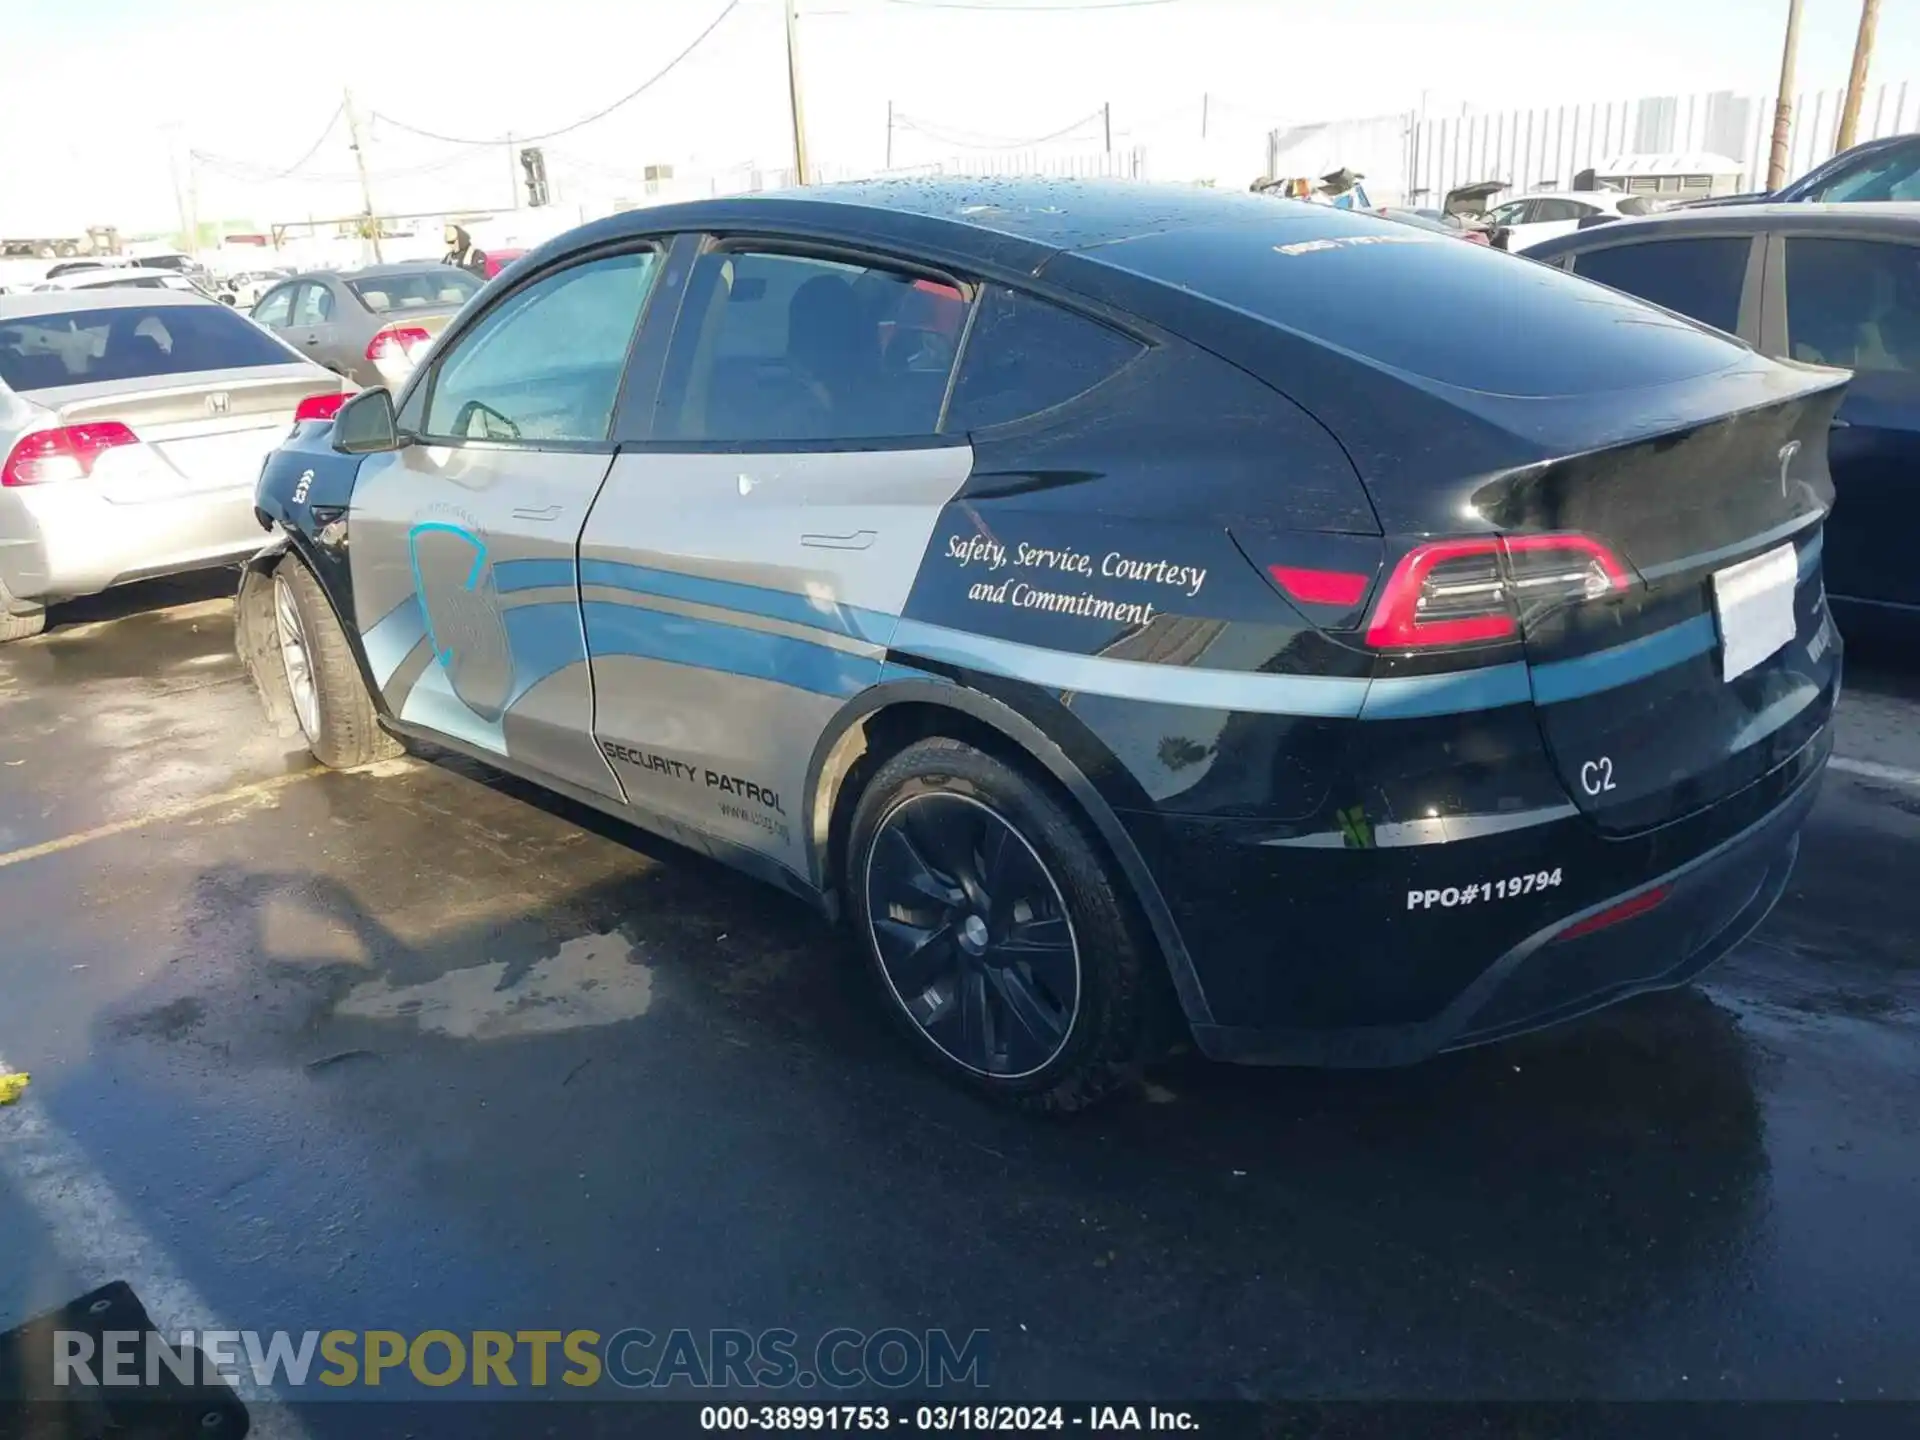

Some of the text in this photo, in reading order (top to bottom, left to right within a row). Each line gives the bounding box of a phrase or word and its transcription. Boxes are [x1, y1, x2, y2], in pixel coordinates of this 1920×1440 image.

[945, 534, 1207, 597] Safety, Service, Courtesy
[968, 578, 1154, 625] and Commitment
[603, 741, 787, 817] SECURITY PATROL
[1581, 756, 1617, 796] C2
[1407, 867, 1563, 910] PPO#119794
